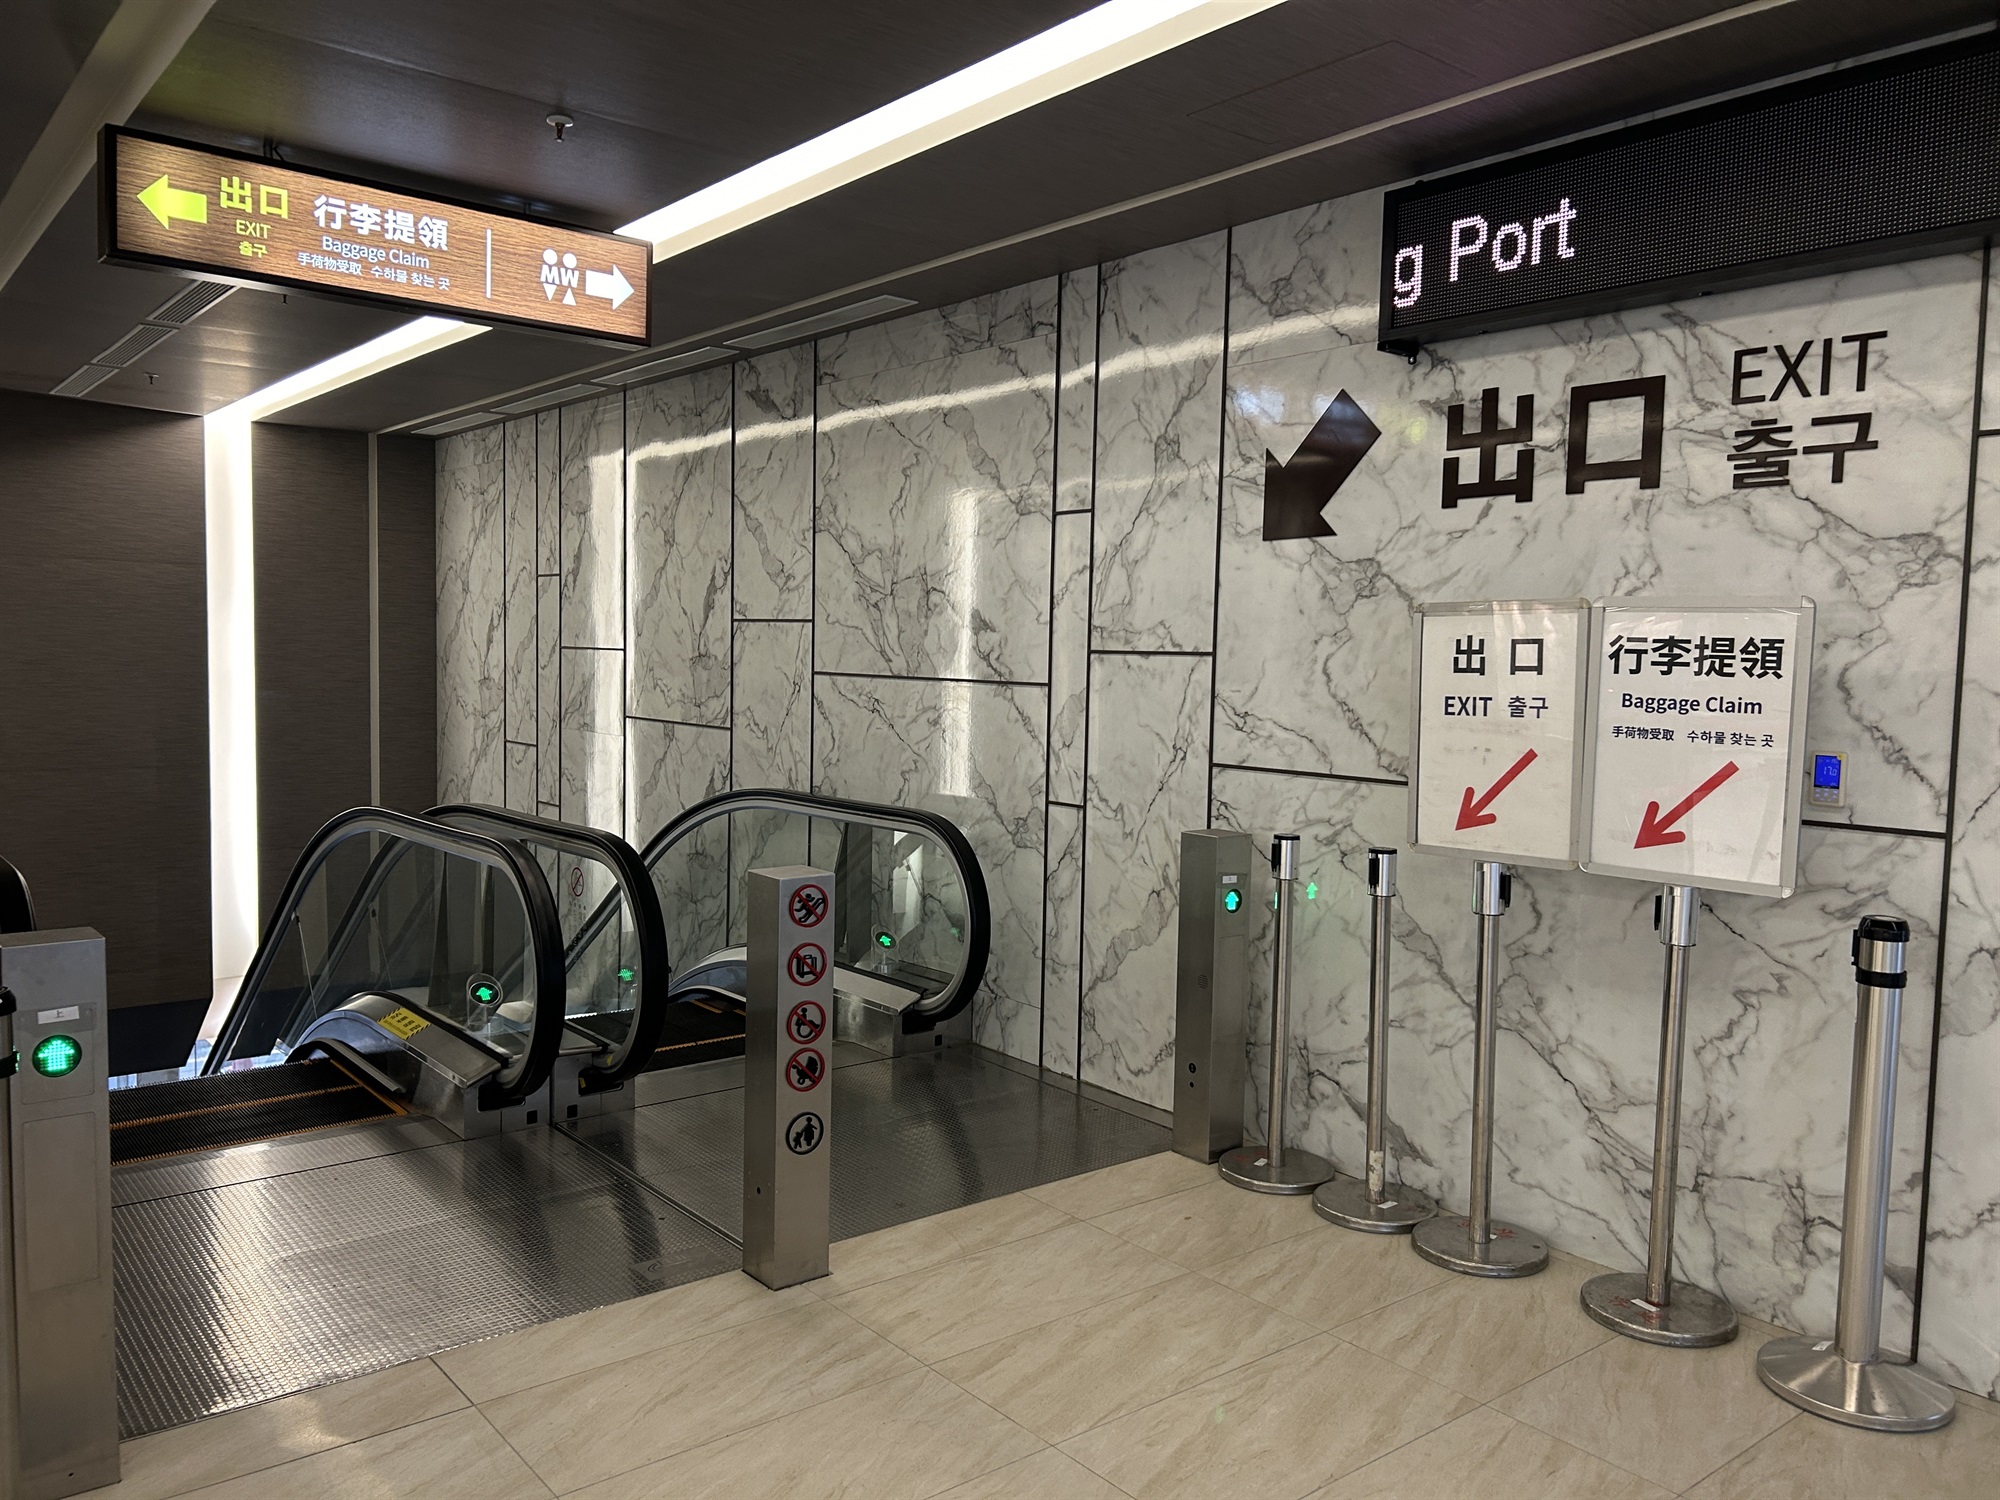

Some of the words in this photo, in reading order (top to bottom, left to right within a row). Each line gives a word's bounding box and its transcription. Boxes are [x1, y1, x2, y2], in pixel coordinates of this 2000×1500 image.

[220, 176, 288, 219] 出口
[236, 219, 271, 239] EXIT
[313, 195, 448, 251] 行李提領
[1449, 197, 1577, 282] Port
[239, 241, 268, 258] 출구
[322, 235, 386, 263] Baggage
[389, 249, 430, 269] Claim
[297, 252, 362, 276] 手荷物受取
[370, 265, 407, 284] 수하물
[411, 272, 435, 288] 찾는
[438, 277, 451, 291] 곳
[1731, 330, 1888, 406] EXIT
[1441, 375, 1666, 509] 出口
[1726, 412, 1879, 490] 출구
[1453, 635, 1544, 676] 出口
[1608, 635, 1785, 680] 行李提領
[1444, 696, 1493, 717] EXIT
[1508, 695, 1549, 719] 출구
[1621, 692, 1700, 715] Baggage
[1705, 696, 1763, 715] Claim
[1612, 725, 1675, 741] 手荷物受取
[1687, 730, 1726, 745] 수하물
[1730, 732, 1757, 747] 찾는
[1761, 734, 1774, 748] 곳
